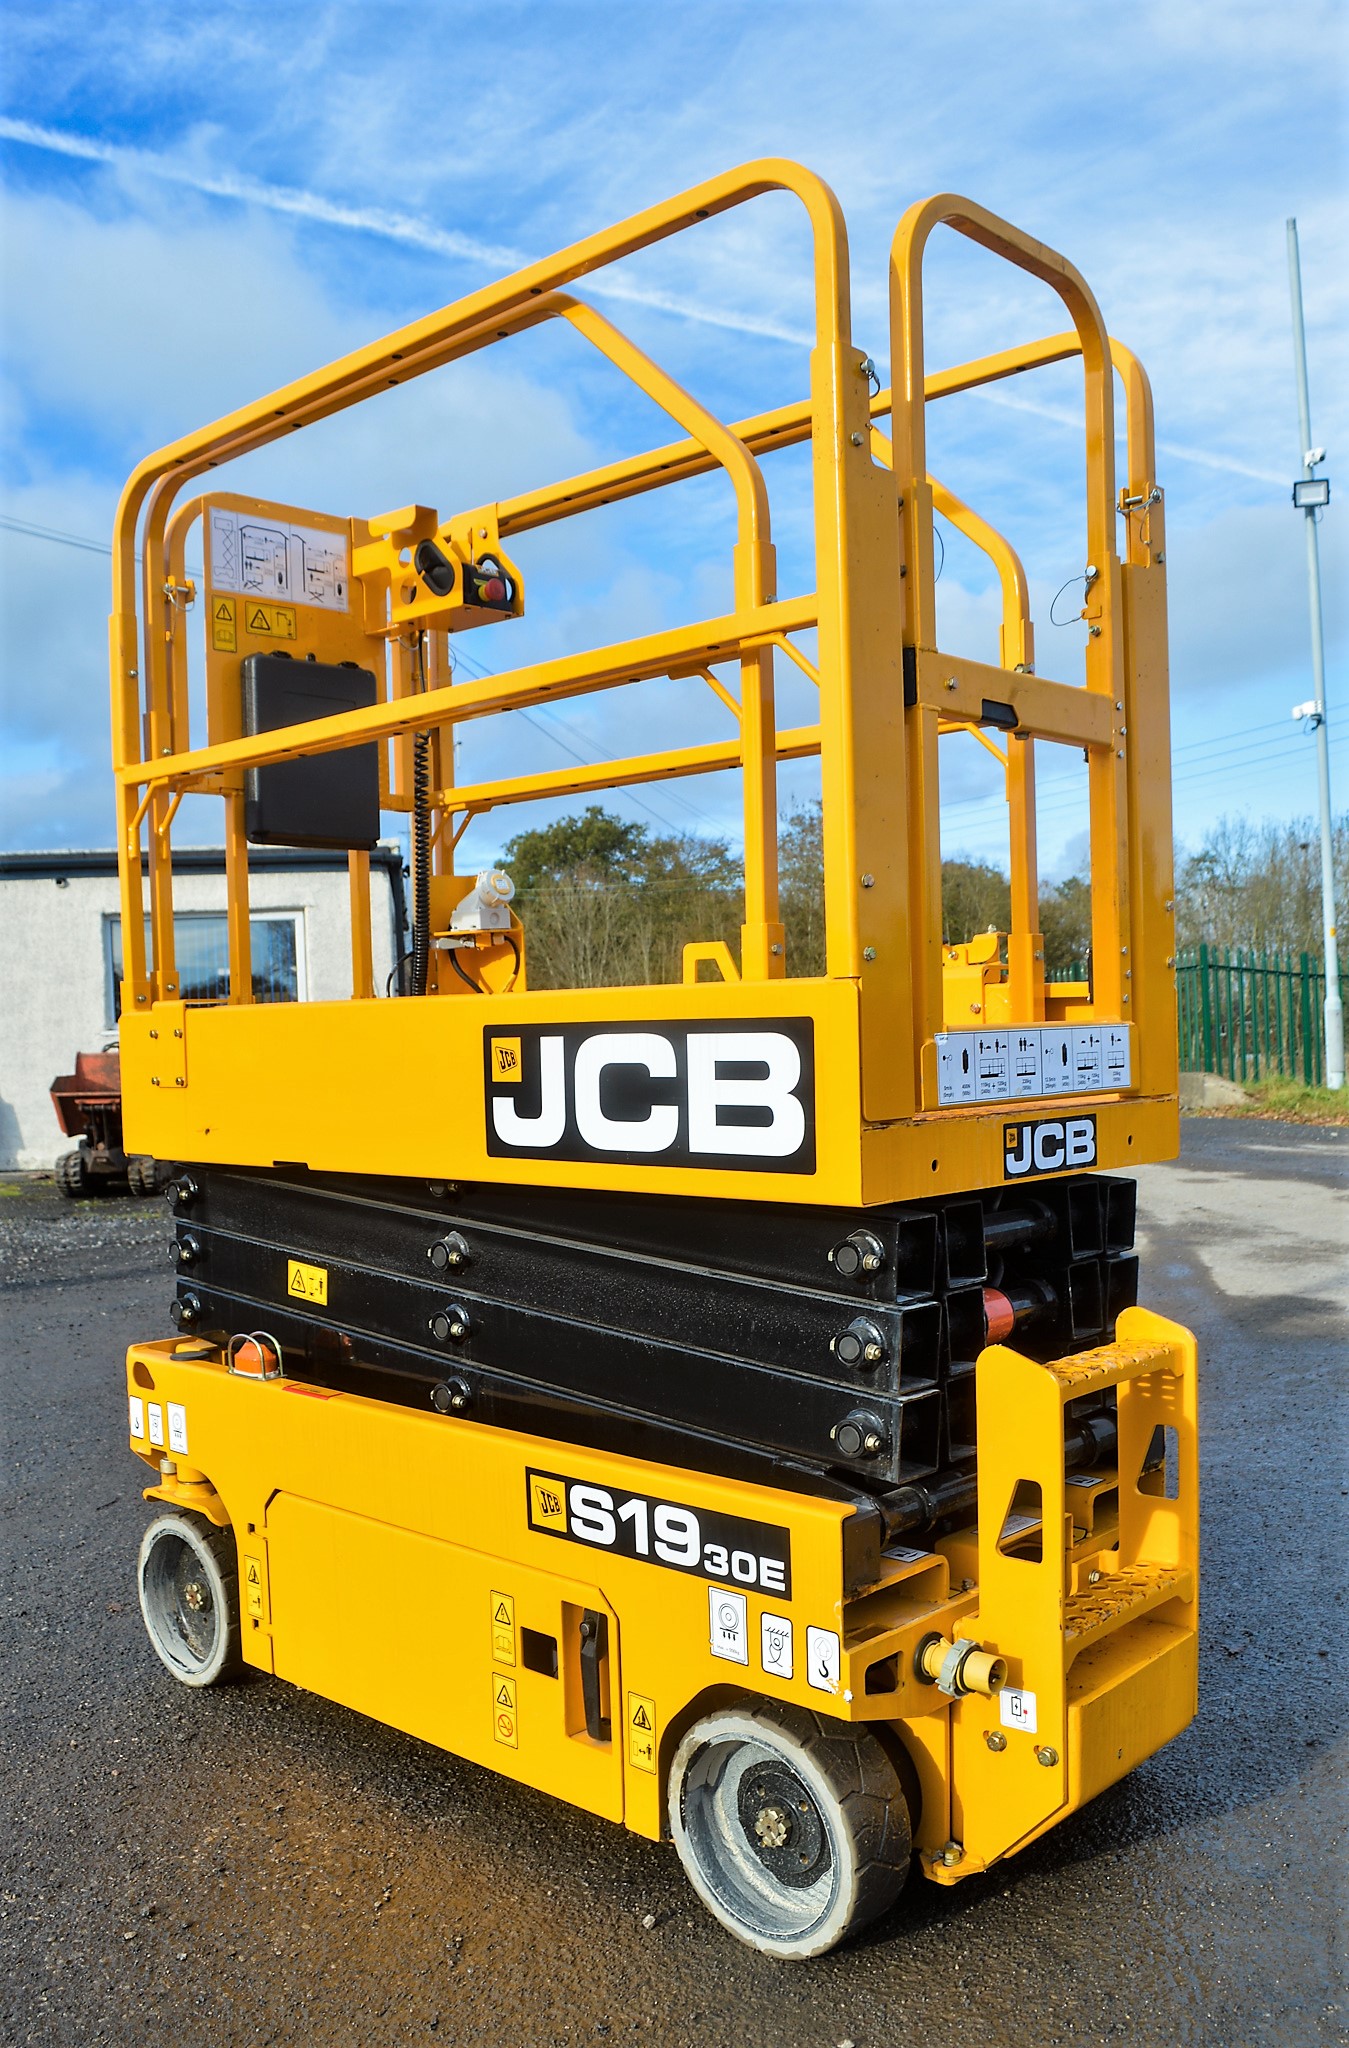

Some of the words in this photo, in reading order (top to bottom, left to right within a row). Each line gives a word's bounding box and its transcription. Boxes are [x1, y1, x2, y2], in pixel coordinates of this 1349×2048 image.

[499, 1049, 516, 1070] JCB
[491, 1031, 806, 1158] JCB
[1006, 1119, 1096, 1174] JCB
[540, 1489, 561, 1514] JCB
